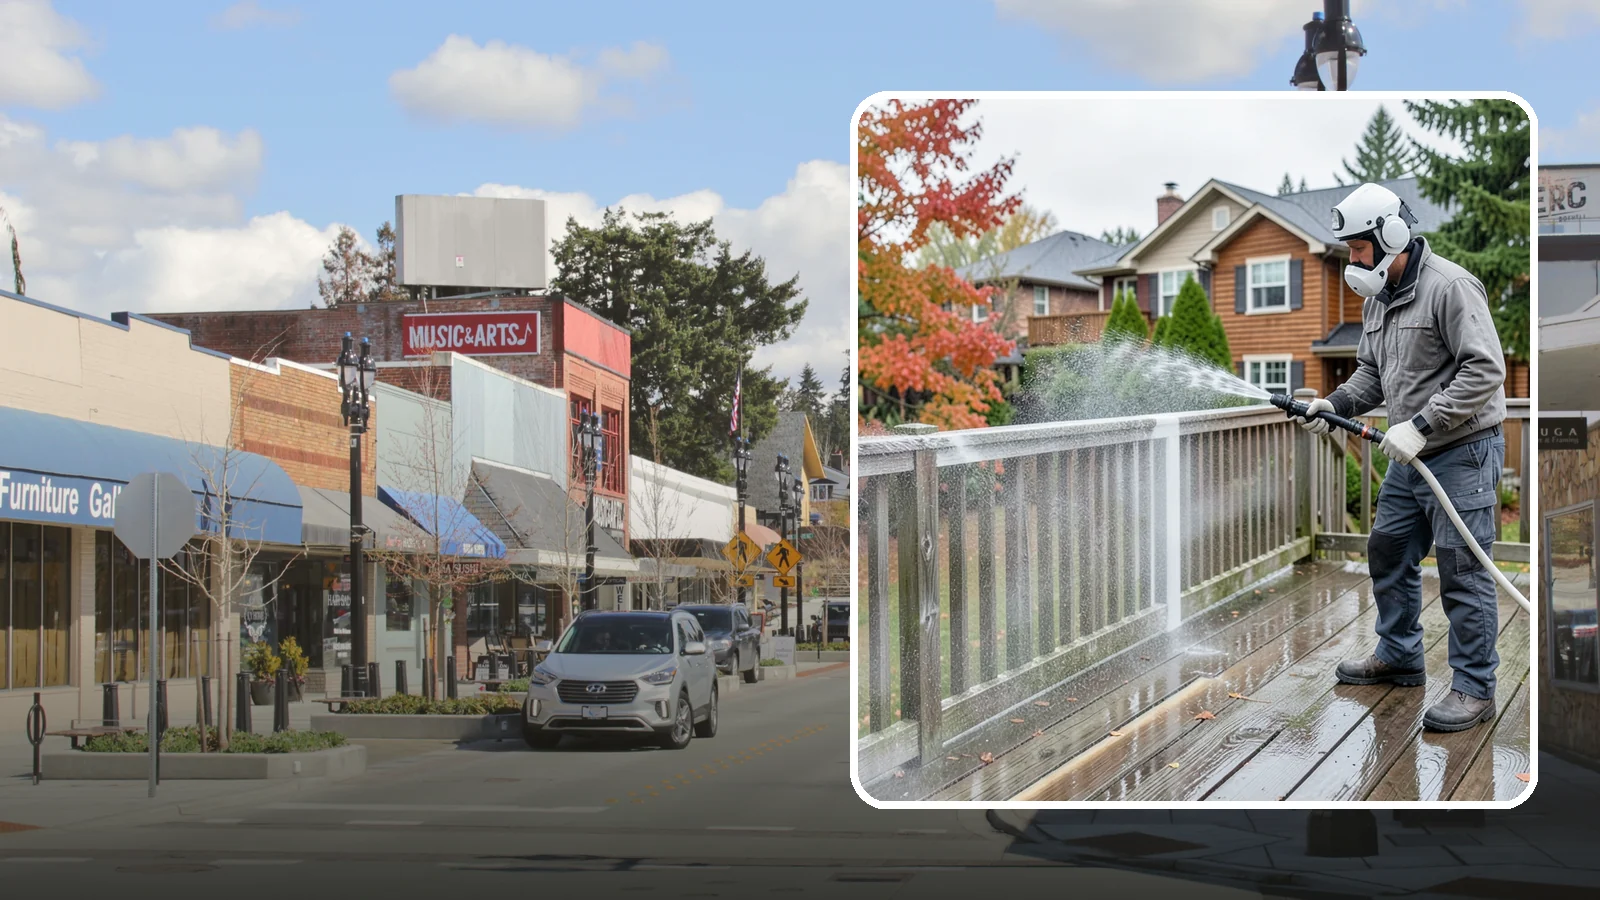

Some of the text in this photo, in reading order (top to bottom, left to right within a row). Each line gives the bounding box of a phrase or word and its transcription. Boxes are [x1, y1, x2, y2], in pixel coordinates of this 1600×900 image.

[1540, 427, 1577, 436] UGA
[0, 471, 122, 519] Furniture Gal
[453, 563, 479, 574] SUSHI
